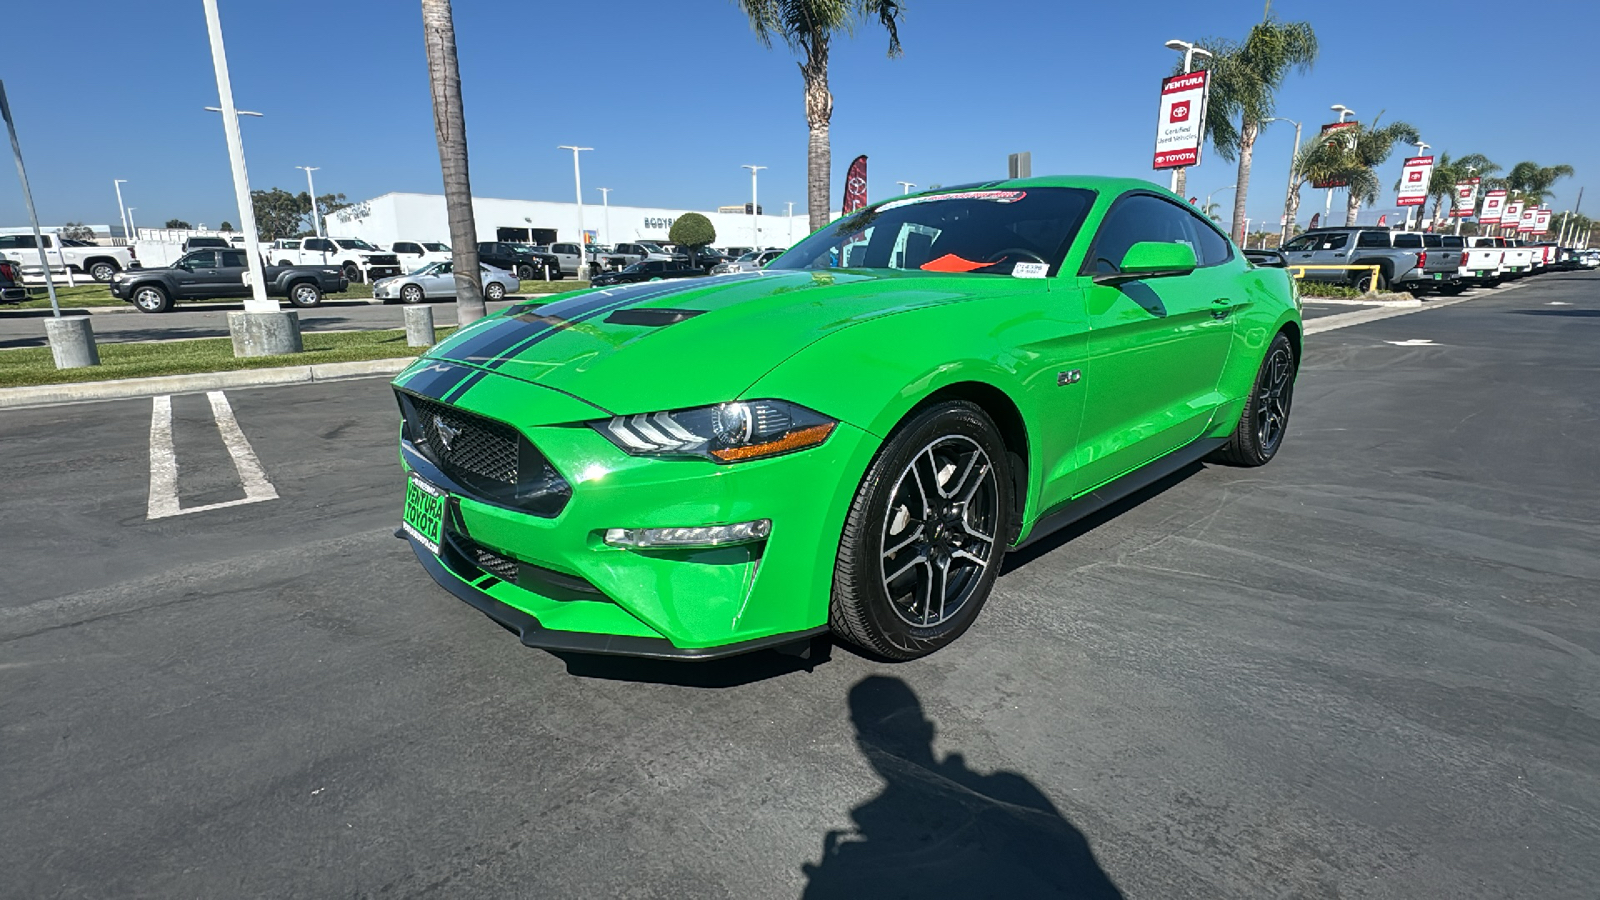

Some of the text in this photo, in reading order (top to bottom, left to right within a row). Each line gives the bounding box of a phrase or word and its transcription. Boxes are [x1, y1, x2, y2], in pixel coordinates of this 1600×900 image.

[1164, 76, 1204, 91] VENTURA
[1165, 152, 1196, 163] TOYOTA
[408, 482, 443, 521] VENTURA
[407, 501, 439, 541] TOYOTA
